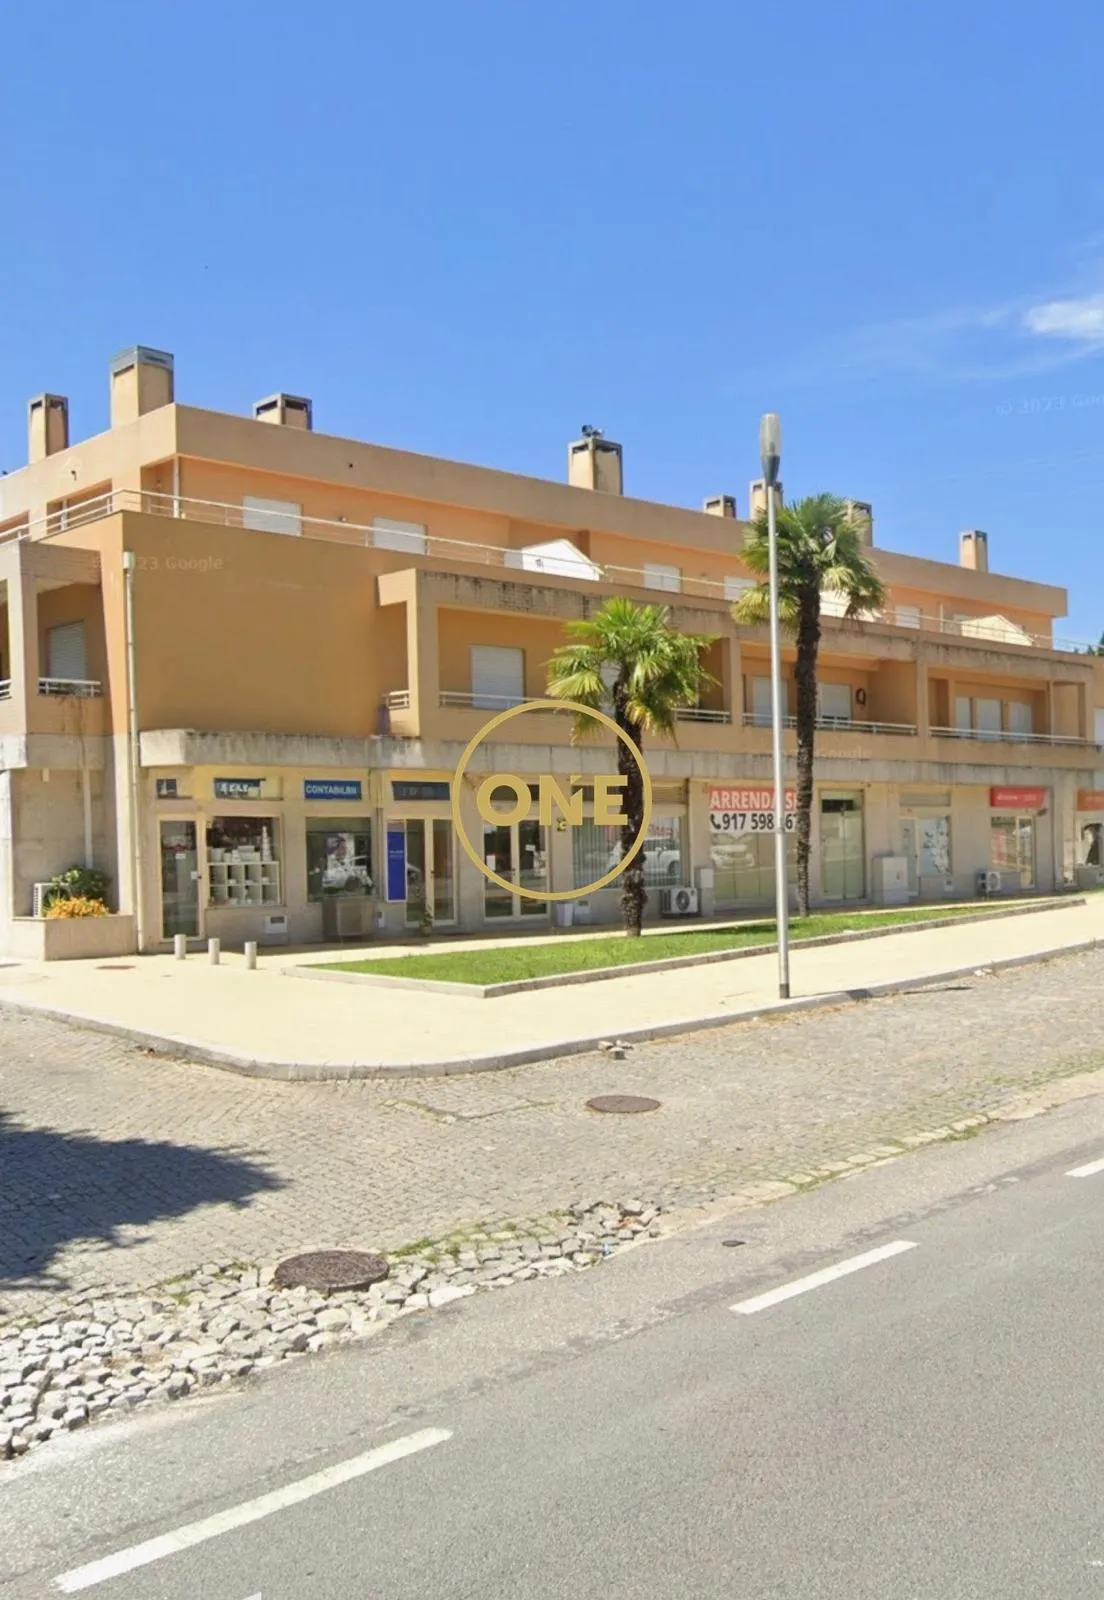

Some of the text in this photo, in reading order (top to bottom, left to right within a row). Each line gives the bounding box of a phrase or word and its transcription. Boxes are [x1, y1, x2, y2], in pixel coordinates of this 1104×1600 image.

[711, 790, 798, 809] ARRENDS
[722, 813, 746, 830] 917
[751, 813, 774, 830] 598
